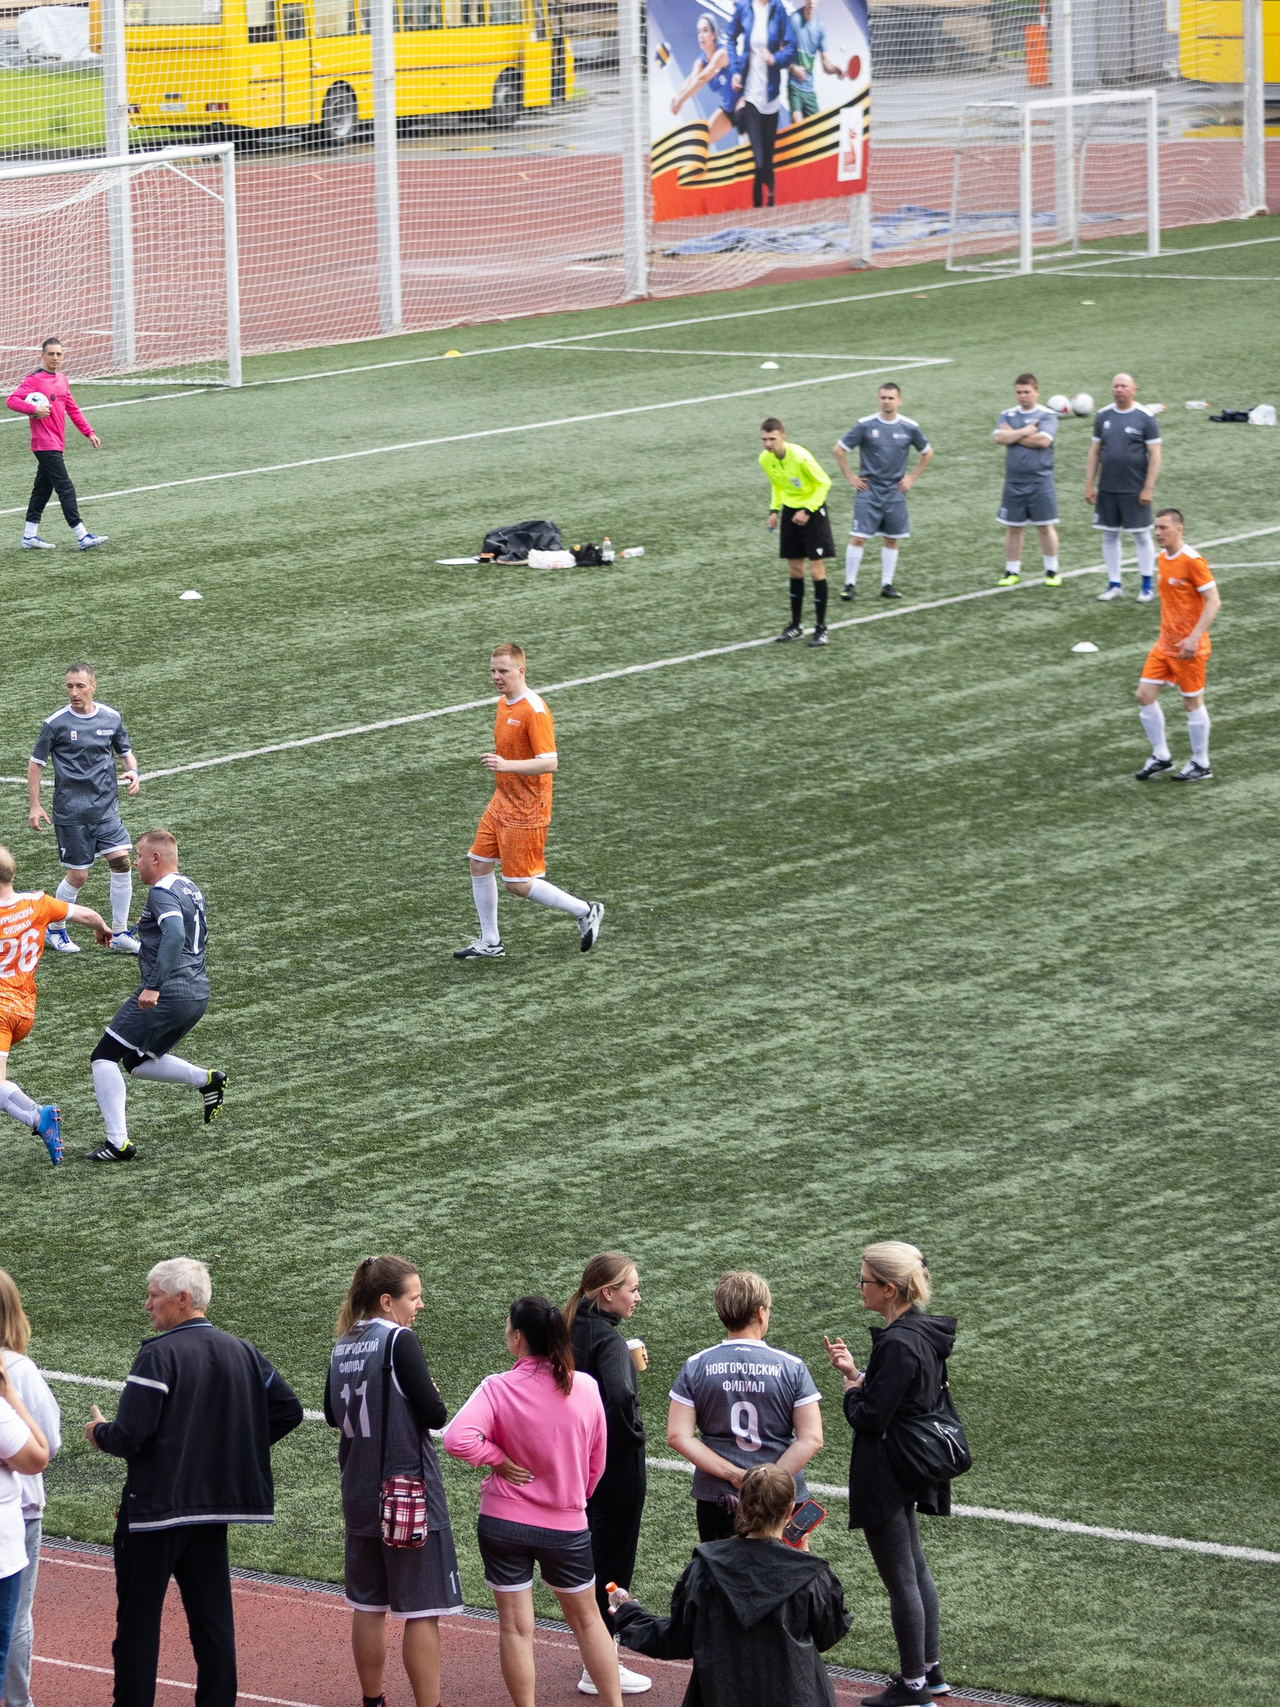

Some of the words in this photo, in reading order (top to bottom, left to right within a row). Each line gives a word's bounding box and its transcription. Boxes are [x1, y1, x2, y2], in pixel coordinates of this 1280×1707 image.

[705, 1362, 782, 1378] НОВГОРОДСКИЙ
[722, 1380, 765, 1393] ФИЛИАЛ
[340, 1381, 371, 1438] 11
[730, 1401, 762, 1452] 9
